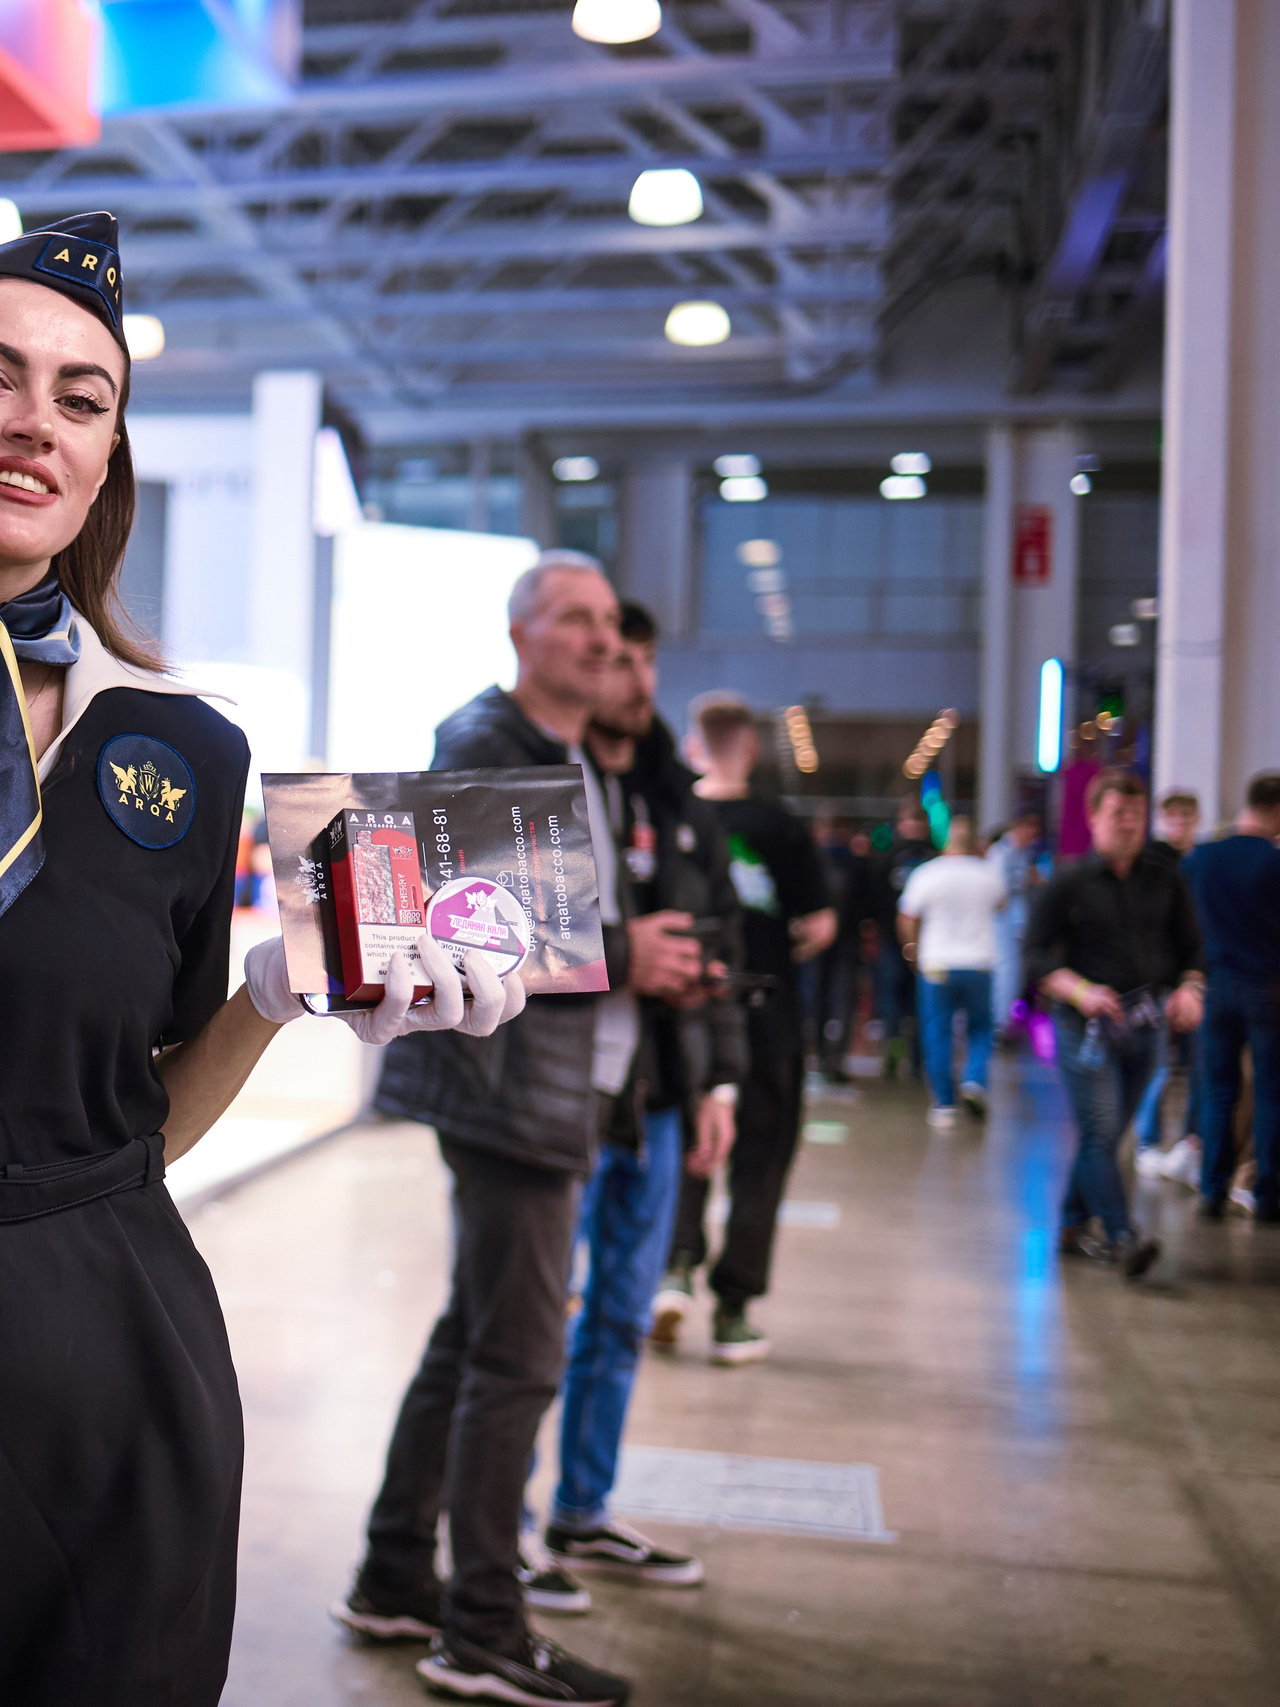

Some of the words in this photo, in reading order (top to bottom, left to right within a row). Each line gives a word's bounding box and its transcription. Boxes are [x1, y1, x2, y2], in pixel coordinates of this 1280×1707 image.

[119, 793, 174, 823] ARQA
[349, 812, 411, 825] ARQA
[316, 863, 327, 899] ARQA
[397, 873, 410, 909] CHERRY
[548, 815, 571, 940] arqatobacco.com
[388, 934, 416, 942] product
[403, 952, 421, 960] highl
